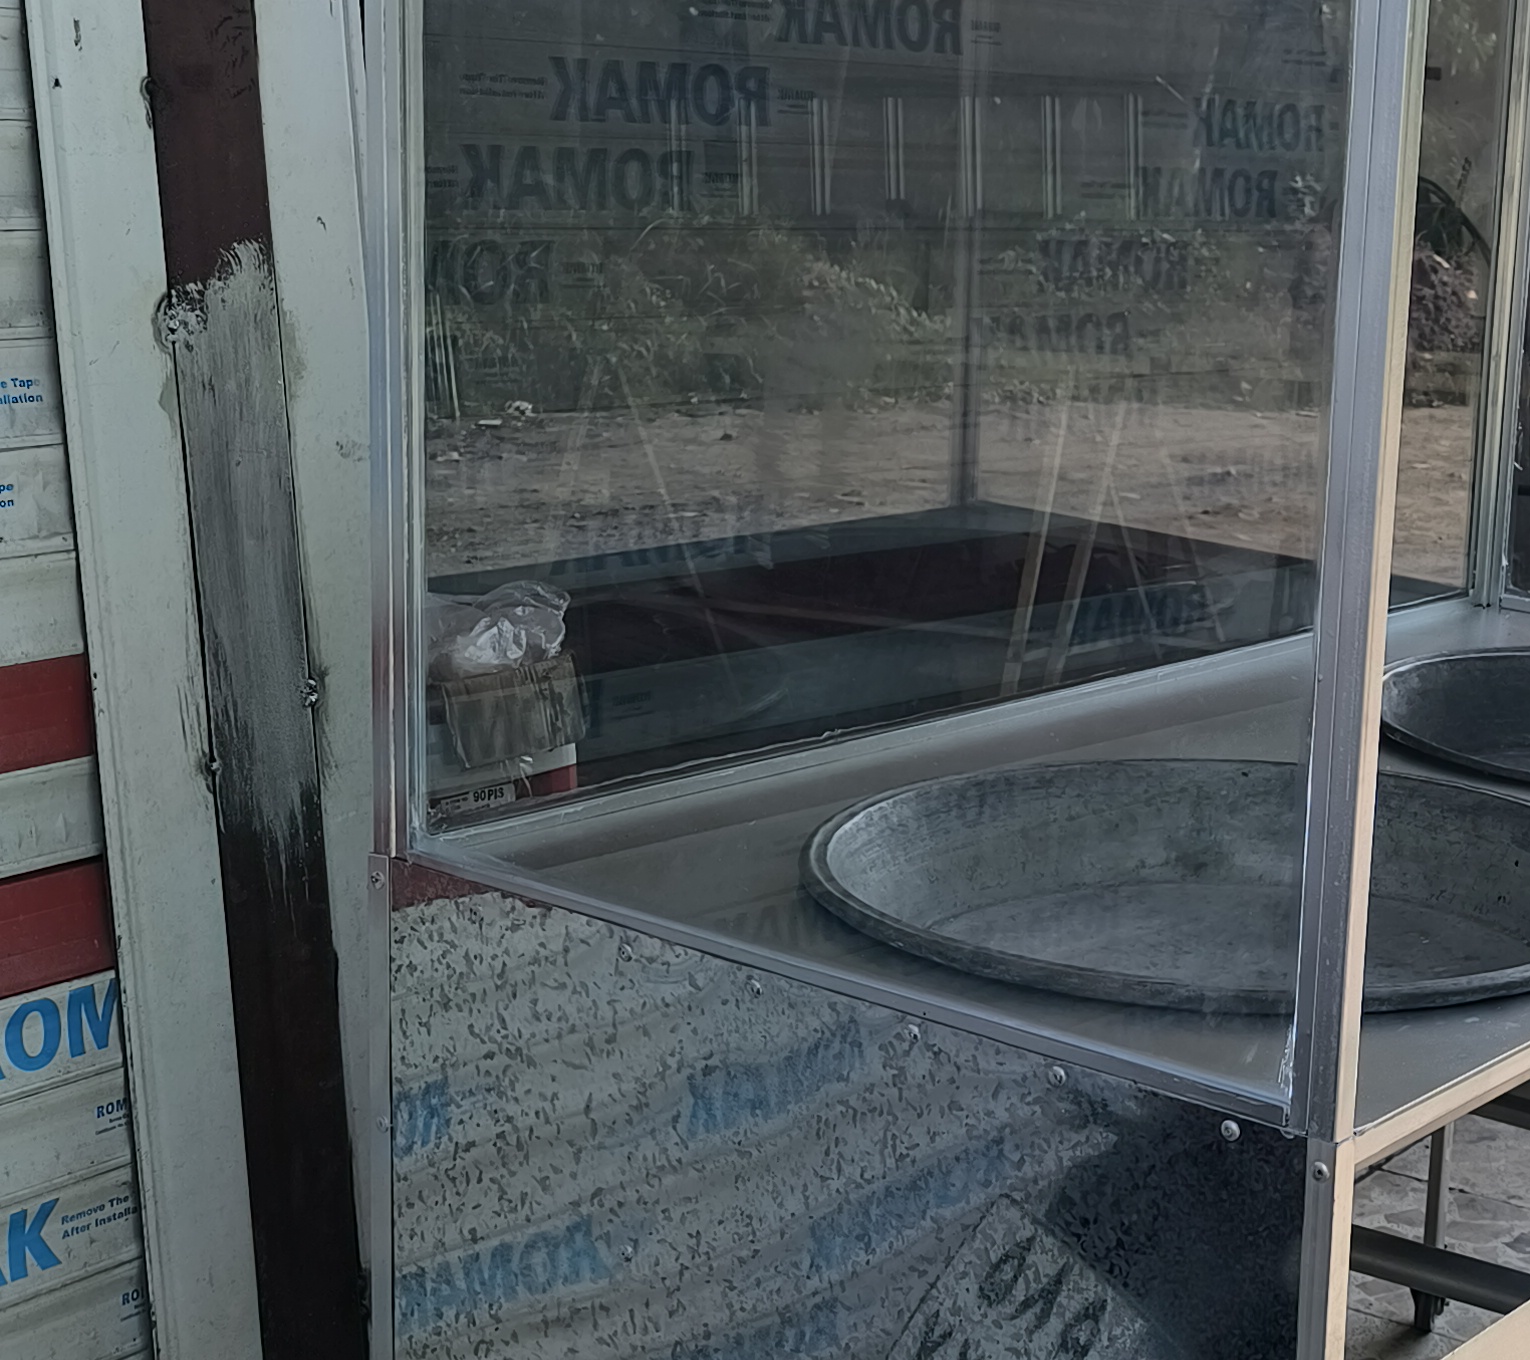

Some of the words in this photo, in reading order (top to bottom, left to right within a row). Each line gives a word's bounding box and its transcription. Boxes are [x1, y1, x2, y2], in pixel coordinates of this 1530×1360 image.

[61, 1203, 105, 1225] Remove
[108, 1195, 130, 1208] The
[62, 1223, 92, 1240] After
